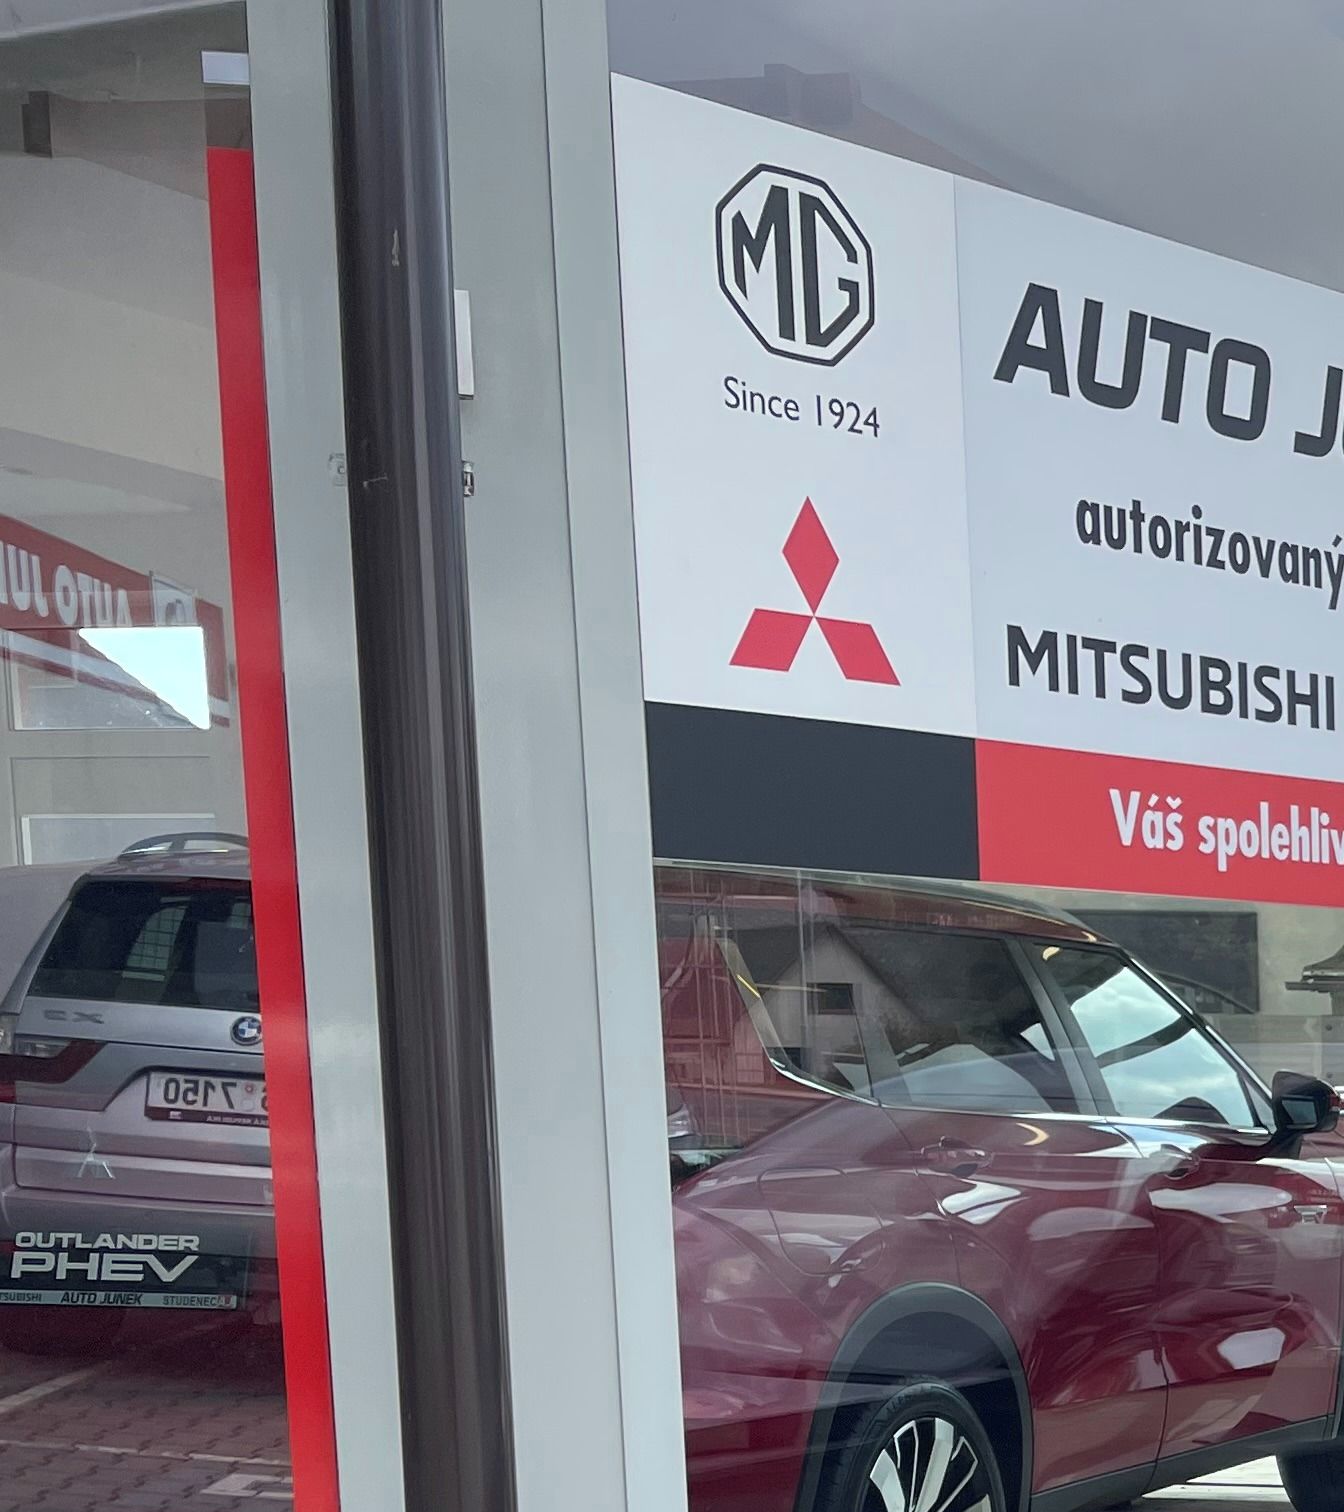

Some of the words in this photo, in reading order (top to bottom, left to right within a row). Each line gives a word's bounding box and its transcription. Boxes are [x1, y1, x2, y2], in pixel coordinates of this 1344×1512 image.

[732, 184, 860, 349] MG
[994, 282, 1271, 442] AUTO
[724, 376, 800, 422] Since
[816, 395, 881, 438] 1924
[1006, 623, 1336, 732] MITSUBISHI
[1109, 788, 1184, 852] Váš
[10, 1251, 200, 1283] PHEV
[15, 1231, 200, 1250] OUTLANDER
[61, 1292, 97, 1304] AUTO
[100, 1292, 143, 1305] JUNEK
